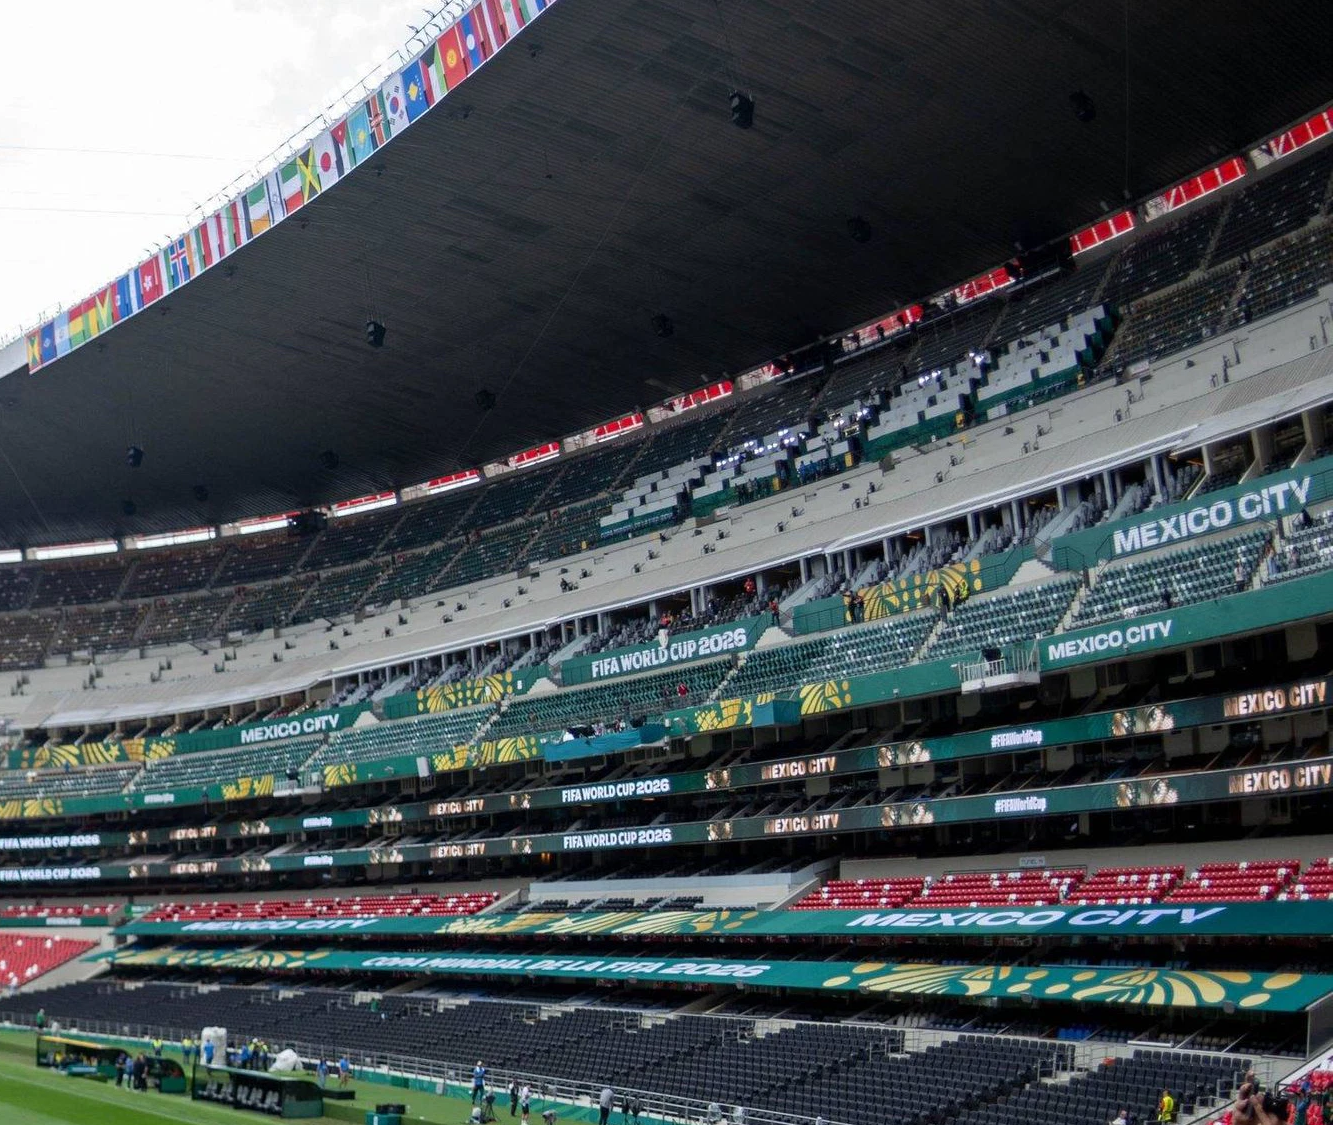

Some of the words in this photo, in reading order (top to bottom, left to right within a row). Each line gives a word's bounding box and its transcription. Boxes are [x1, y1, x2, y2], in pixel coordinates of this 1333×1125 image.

[1113, 500, 1232, 554] MEXICO
[1238, 476, 1311, 520] CITY
[1048, 629, 1123, 661] MEXICO
[1125, 620, 1173, 645] CITY
[591, 657, 620, 678] FIFA
[619, 648, 669, 673] WORLD
[670, 640, 697, 663] CUP
[698, 628, 747, 655] 2026
[1223, 688, 1286, 718] MEXICO
[1288, 682, 1327, 707] CITY
[240, 720, 301, 744] MEXICO
[303, 713, 339, 735] CITY
[990, 729, 1042, 748] #FIFAWorldCup
[761, 760, 806, 780] MEXICO
[807, 757, 837, 775] CITY
[1228, 768, 1291, 794] MEXICO
[1293, 764, 1331, 789] CITY
[562, 788, 582, 803] FIFA
[582, 786, 616, 802] WORLD
[617, 783, 635, 797] CUP
[636, 778, 670, 796] 2026
[429, 800, 462, 816] MEXICO
[463, 797, 485, 813] CITY
[764, 817, 809, 835] MEXICO
[810, 814, 839, 832] CITY
[20, 836, 51, 850] WORLD
[52, 835, 69, 849] CUP
[70, 834, 101, 847] 2026
[464, 842, 486, 856] CITY
[563, 835, 583, 849] FIFA
[583, 833, 617, 848] WORLD
[618, 831, 637, 846] CUP
[638, 828, 672, 844] 2026
[0, 869, 21, 881] FIFA
[21, 868, 52, 881] WORLD
[53, 867, 70, 880] CUP
[182, 919, 297, 931] MEXICO
[296, 919, 379, 930] CITY
[847, 911, 1066, 927] MEXICO
[1069, 906, 1226, 926] CITY
[362, 956, 427, 968] COPA
[421, 957, 532, 970] MUNDIAL
[530, 959, 570, 971] DE
[569, 960, 604, 972] LA
[597, 961, 665, 973] FIFA
[659, 963, 770, 977] 2026
